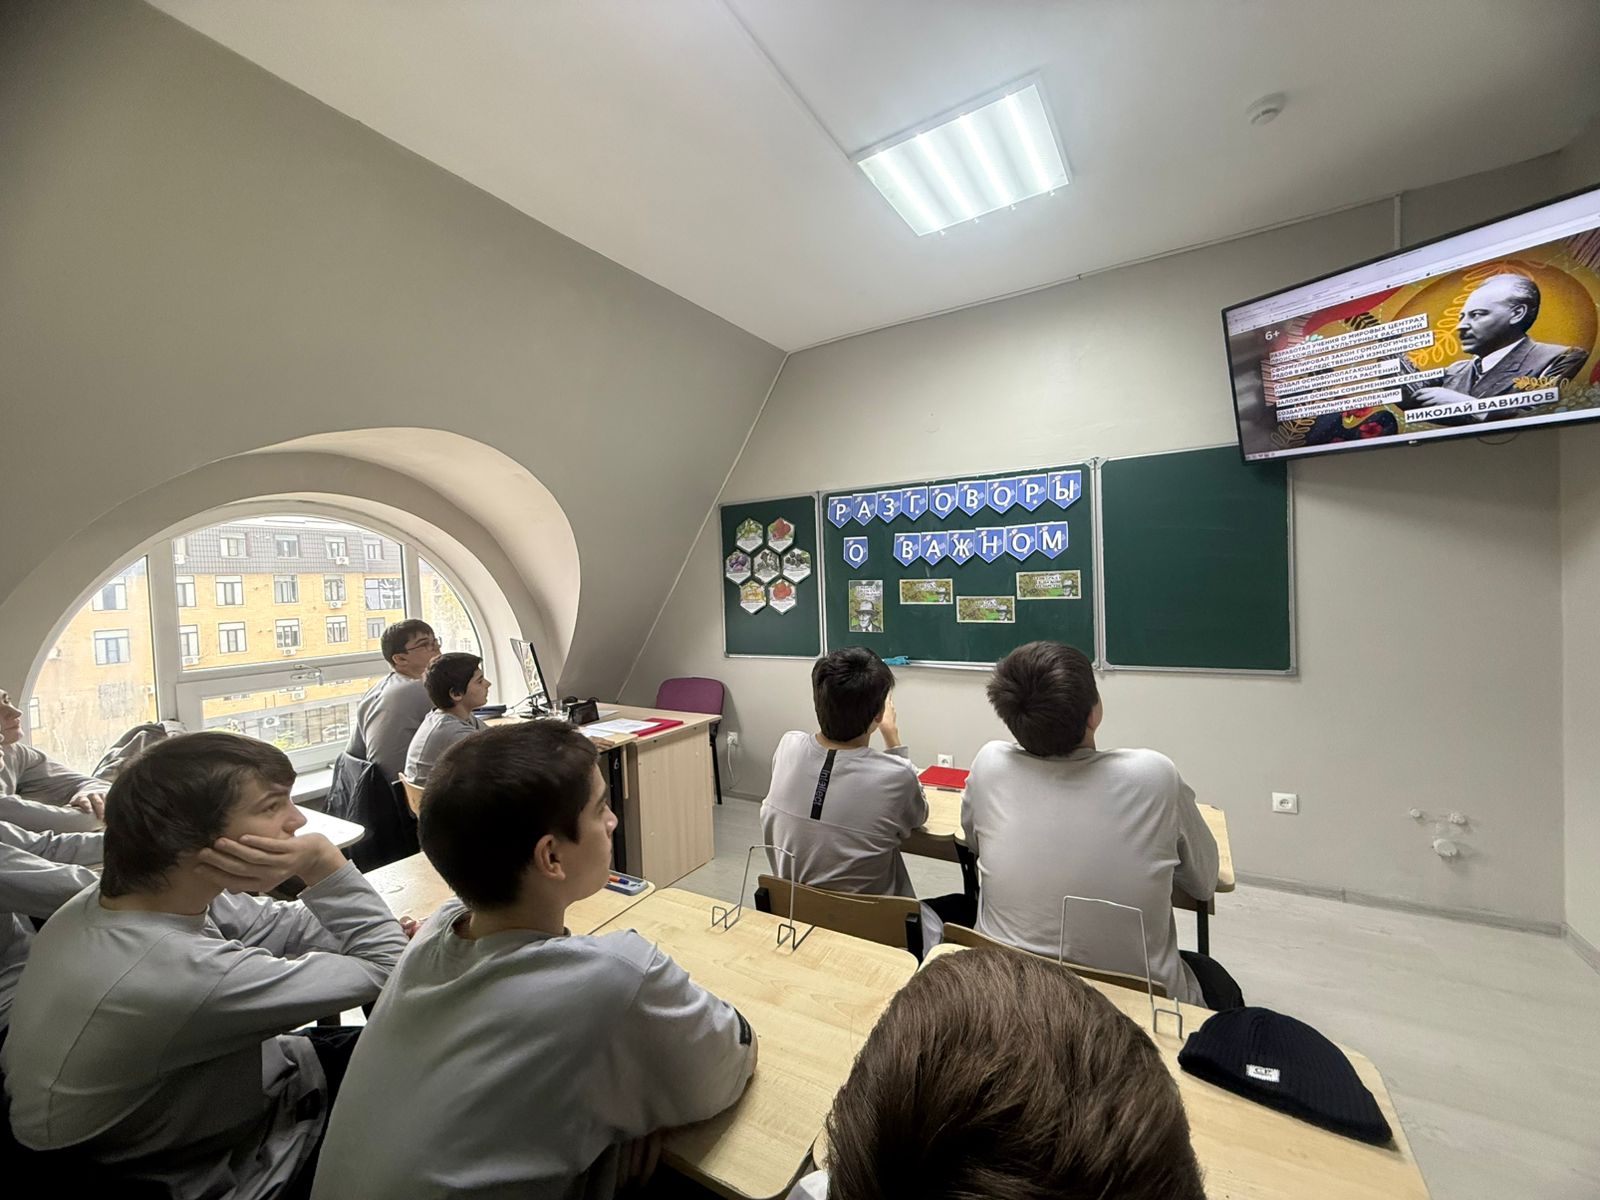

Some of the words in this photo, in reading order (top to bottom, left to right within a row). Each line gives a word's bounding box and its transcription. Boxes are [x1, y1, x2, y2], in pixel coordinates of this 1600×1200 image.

[1265, 330, 1280, 340] 6+
[1270, 344, 1311, 358] РАЗРАБОТАЛ
[1312, 337, 1340, 349] УЧЕНИЯ
[1348, 326, 1386, 339] МИРОВЫХ
[1388, 316, 1425, 330] ЦЕНТРАХ
[1271, 347, 1330, 363] ПРОИСХОЖДЕНИЯ
[1330, 333, 1379, 350] КУЛЬТУРНЫХ
[1380, 323, 1423, 337] РАСТЕНИЙ
[1271, 357, 1330, 374] СФОРМУЛИРОВАЛ
[1331, 350, 1355, 360] ЗАКОН
[1356, 333, 1431, 354] ГОМОЛОГИЧЕСКИХ
[1272, 371, 1293, 380] РЯДОВ
[1300, 354, 1365, 373] НАСЛЕДСТВЕННОЙ
[1366, 340, 1431, 358] ИЗМЕНЧИВОСТИ
[1275, 381, 1300, 390] СОЗДАЛ
[1301, 364, 1382, 384] ОСНОВОПОЛАГАЮЩИЕ
[1275, 385, 1311, 395] ПРИНЦИПЫ
[1311, 374, 1358, 387] ИММУНИТЕТА
[1359, 366, 1399, 377] РАСТЕНИЙ
[1277, 396, 1308, 406] ЗАЛОЖИЛ
[1309, 390, 1339, 400] ОСНОВЫ
[1340, 378, 1397, 394] СОВРЕМЕННОЙ
[1398, 370, 1443, 383] СЕЛЕКЦИИ
[1277, 407, 1302, 417] СОЗДАЛ
[1303, 400, 1351, 413] УНИКАЛЬНУЮ
[1352, 391, 1400, 404] КОЛЛЕКЦИЮ
[1344, 400, 1383, 410] РАСТЕНИЙ
[1406, 402, 1473, 421] НИКОЛАЙ
[1478, 391, 1555, 410] ВАВИЛОВ
[835, 479, 1075, 521] РАЗГОВОРЫ
[849, 543, 865, 562] О
[901, 530, 1063, 559] ВАЖНОМ
